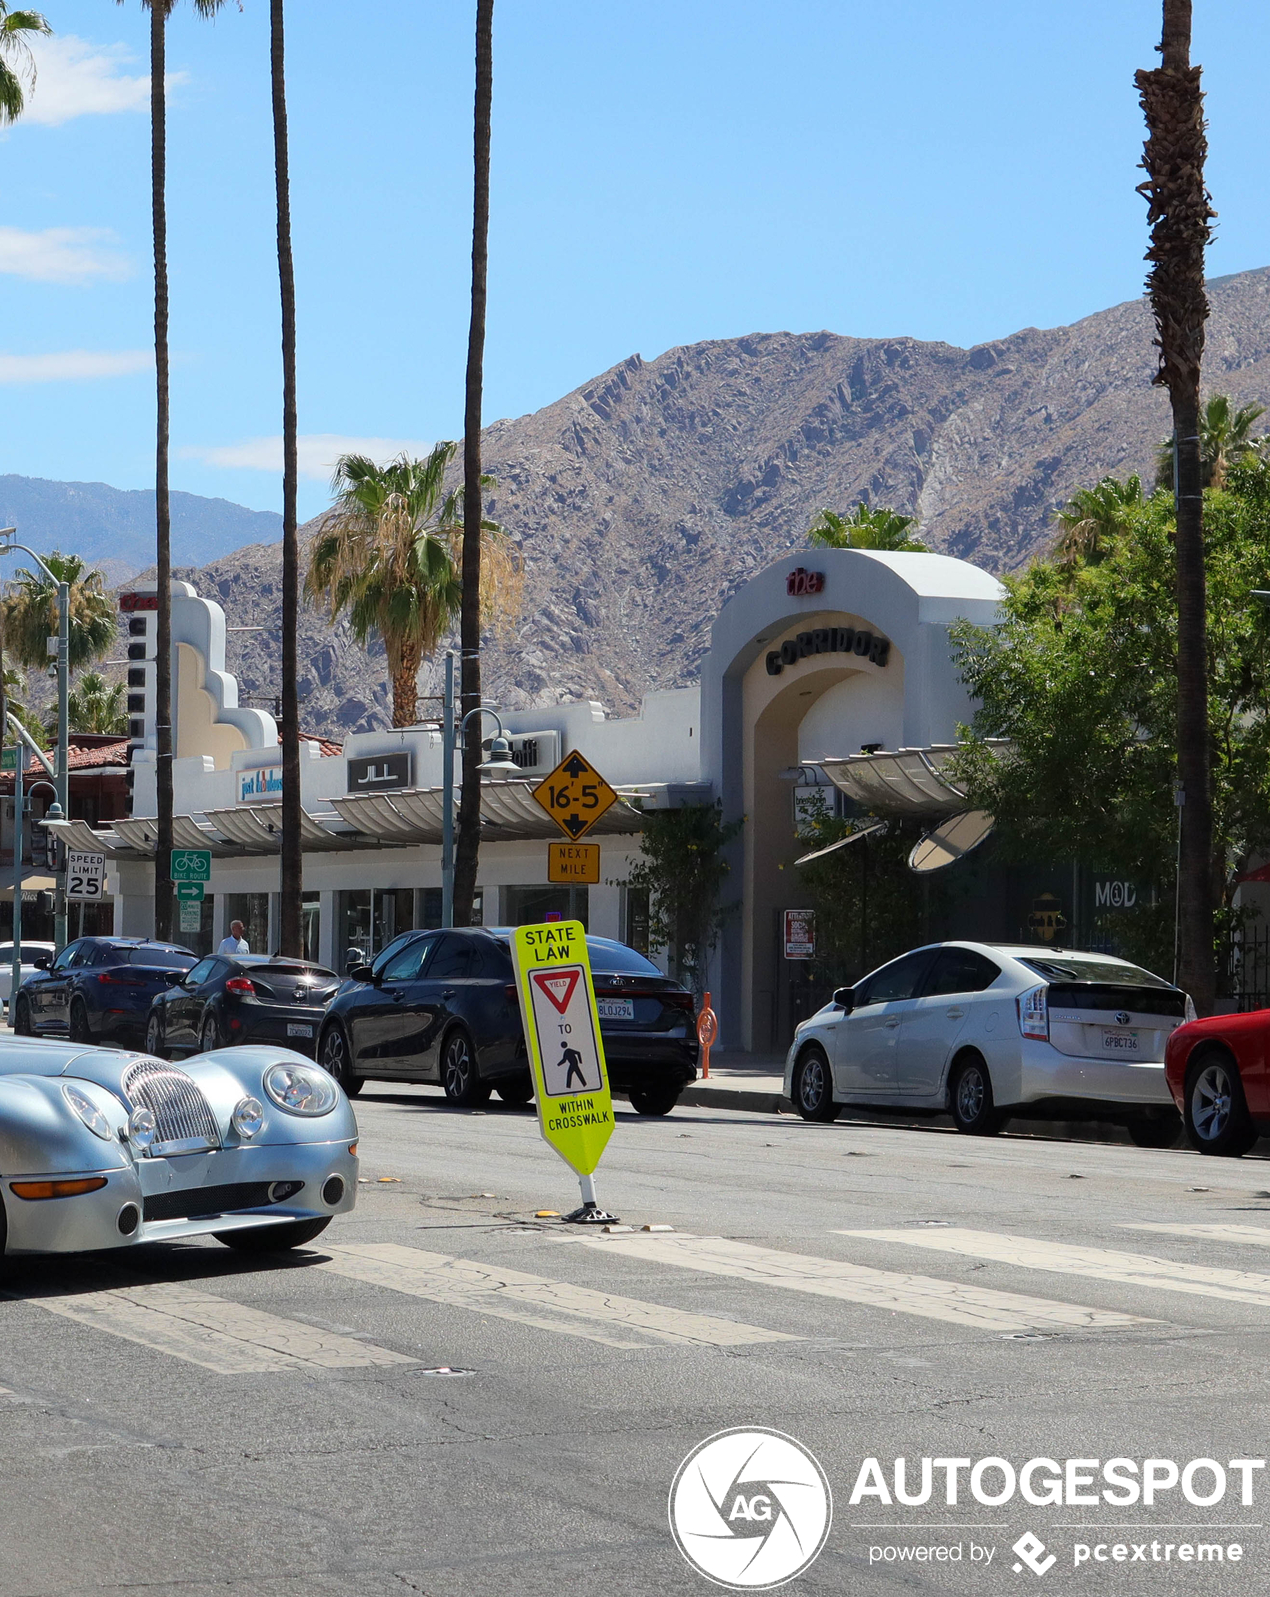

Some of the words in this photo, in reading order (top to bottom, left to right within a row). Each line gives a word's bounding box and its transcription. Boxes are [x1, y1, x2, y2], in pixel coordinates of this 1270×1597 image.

[786, 568, 825, 596] the
[766, 627, 890, 675] CORRIDOR
[358, 764, 398, 783] JILL
[241, 776, 254, 800] just
[70, 854, 103, 864] SPEED
[560, 848, 588, 859] NEXT
[72, 866, 100, 875] LIMIT
[560, 864, 586, 874] MILE
[70, 876, 98, 895] 25
[526, 927, 576, 945] STATE
[534, 945, 570, 962] LAW
[549, 980, 567, 988] YIELD
[558, 1024, 572, 1034] TO
[1105, 1038, 1138, 1049] 6PBC736
[559, 1098, 594, 1114] WITHIN
[548, 1111, 610, 1131] CROSSWALK
